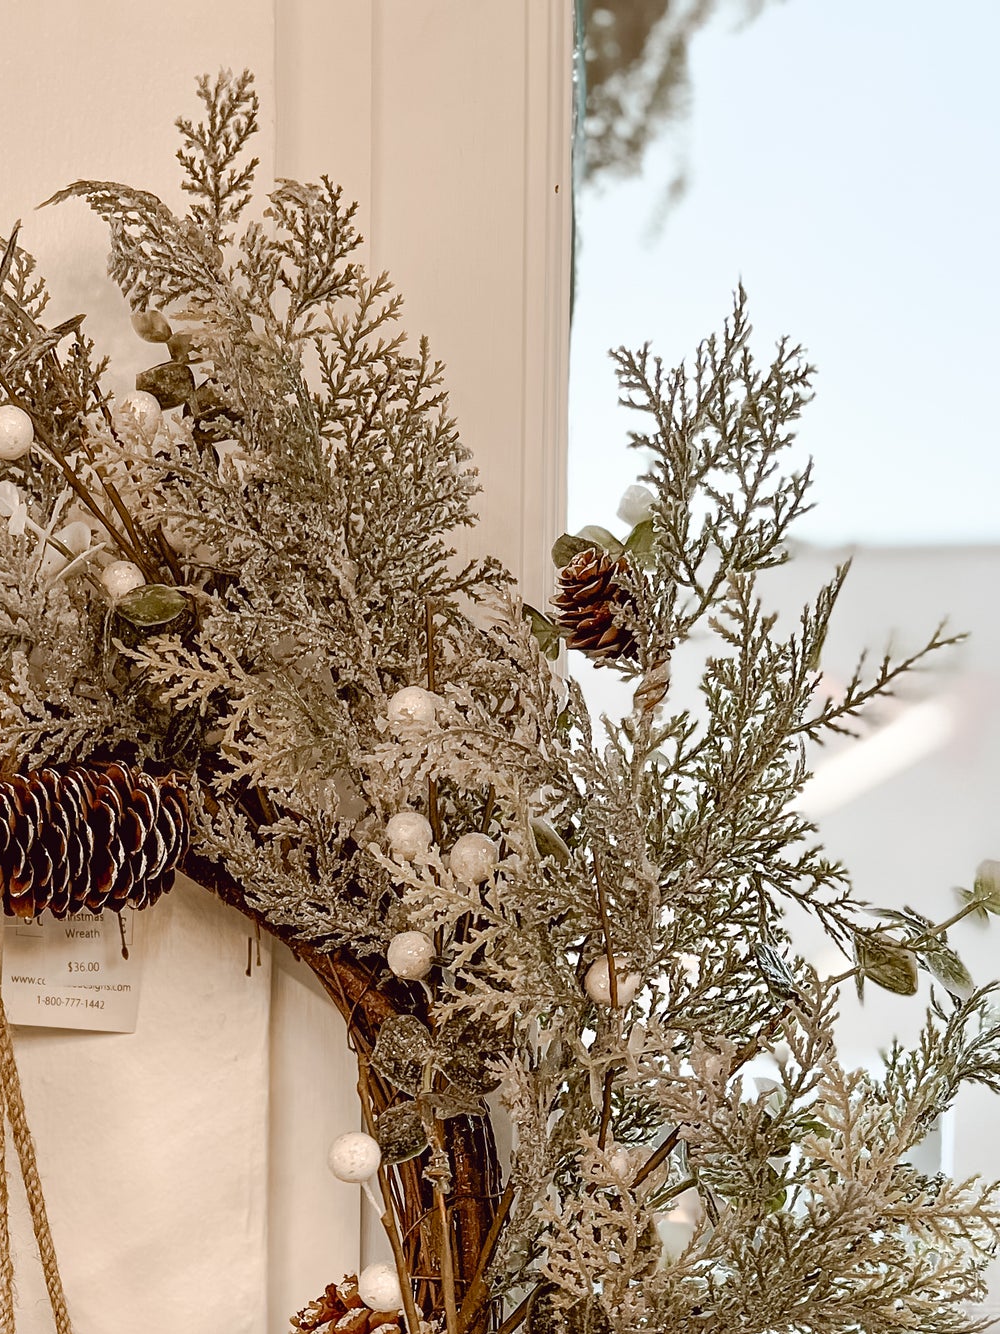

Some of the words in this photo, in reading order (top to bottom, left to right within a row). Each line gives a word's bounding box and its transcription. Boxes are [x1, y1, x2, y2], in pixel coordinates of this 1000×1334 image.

[59, 911, 104, 922] ristmas
[65, 928, 100, 939] Wreath
[68, 961, 100, 973] $36.00
[37, 995, 105, 1010] 1-800-777-1442
